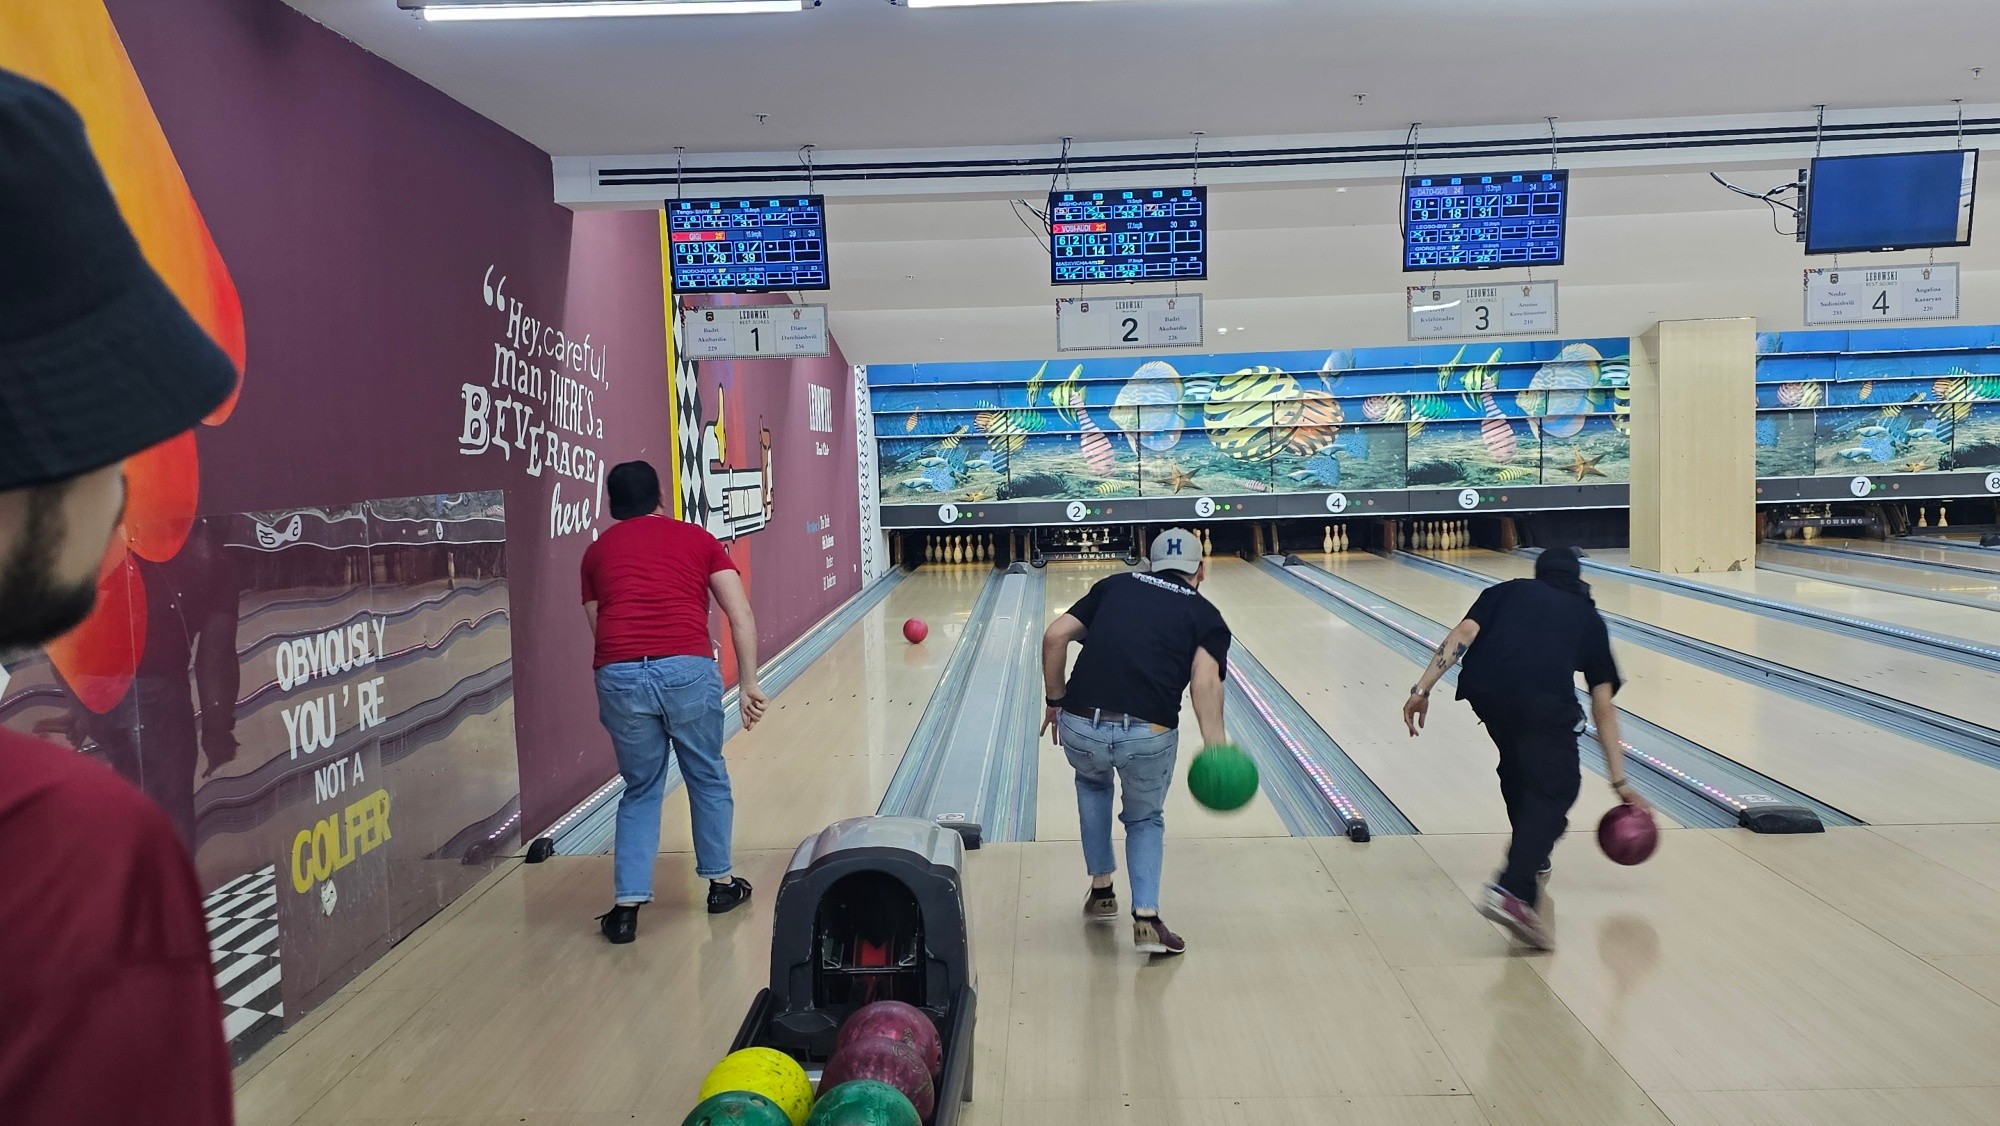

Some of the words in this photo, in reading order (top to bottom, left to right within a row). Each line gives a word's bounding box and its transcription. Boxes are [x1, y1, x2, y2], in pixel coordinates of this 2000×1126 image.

[1415, 200, 1421, 209] 9
[1445, 198, 1452, 207] 9
[1475, 197, 1482, 205] 9
[1506, 196, 1512, 204] 3
[1421, 210, 1429, 220] 9
[1448, 209, 1462, 218] 18
[1479, 208, 1492, 217] 31
[1059, 236, 1066, 245] 6
[1073, 236, 1080, 244] 2
[1089, 235, 1095, 243] 6
[1148, 233, 1154, 242] 7
[679, 245, 686, 253] 6
[692, 244, 699, 252] 3
[738, 243, 744, 252] 9
[1066, 247, 1073, 256] 8
[1092, 246, 1105, 256] 14
[1122, 245, 1135, 254] 23
[686, 256, 693, 264] 9
[713, 254, 726, 264] 29
[743, 253, 755, 263] 39
[1865, 271, 1898, 281] LEBOWSKI
[1872, 290, 1890, 315] 4
[1475, 306, 1489, 330] 3
[1122, 318, 1139, 342] 2
[750, 328, 759, 351] 1
[459, 383, 596, 482] BEVERAGE
[1857, 481, 1865, 492] 7
[1332, 498, 1341, 509] 4
[1465, 494, 1473, 505] 5
[945, 508, 950, 519] 1
[1073, 506, 1081, 517] 2
[1201, 502, 1210, 513] 3
[1167, 538, 1182, 555] H
[276, 616, 386, 692] OBVIOUSLY
[314, 757, 349, 805] NOT
[352, 752, 365, 787] A
[292, 788, 392, 894] GOLFER
